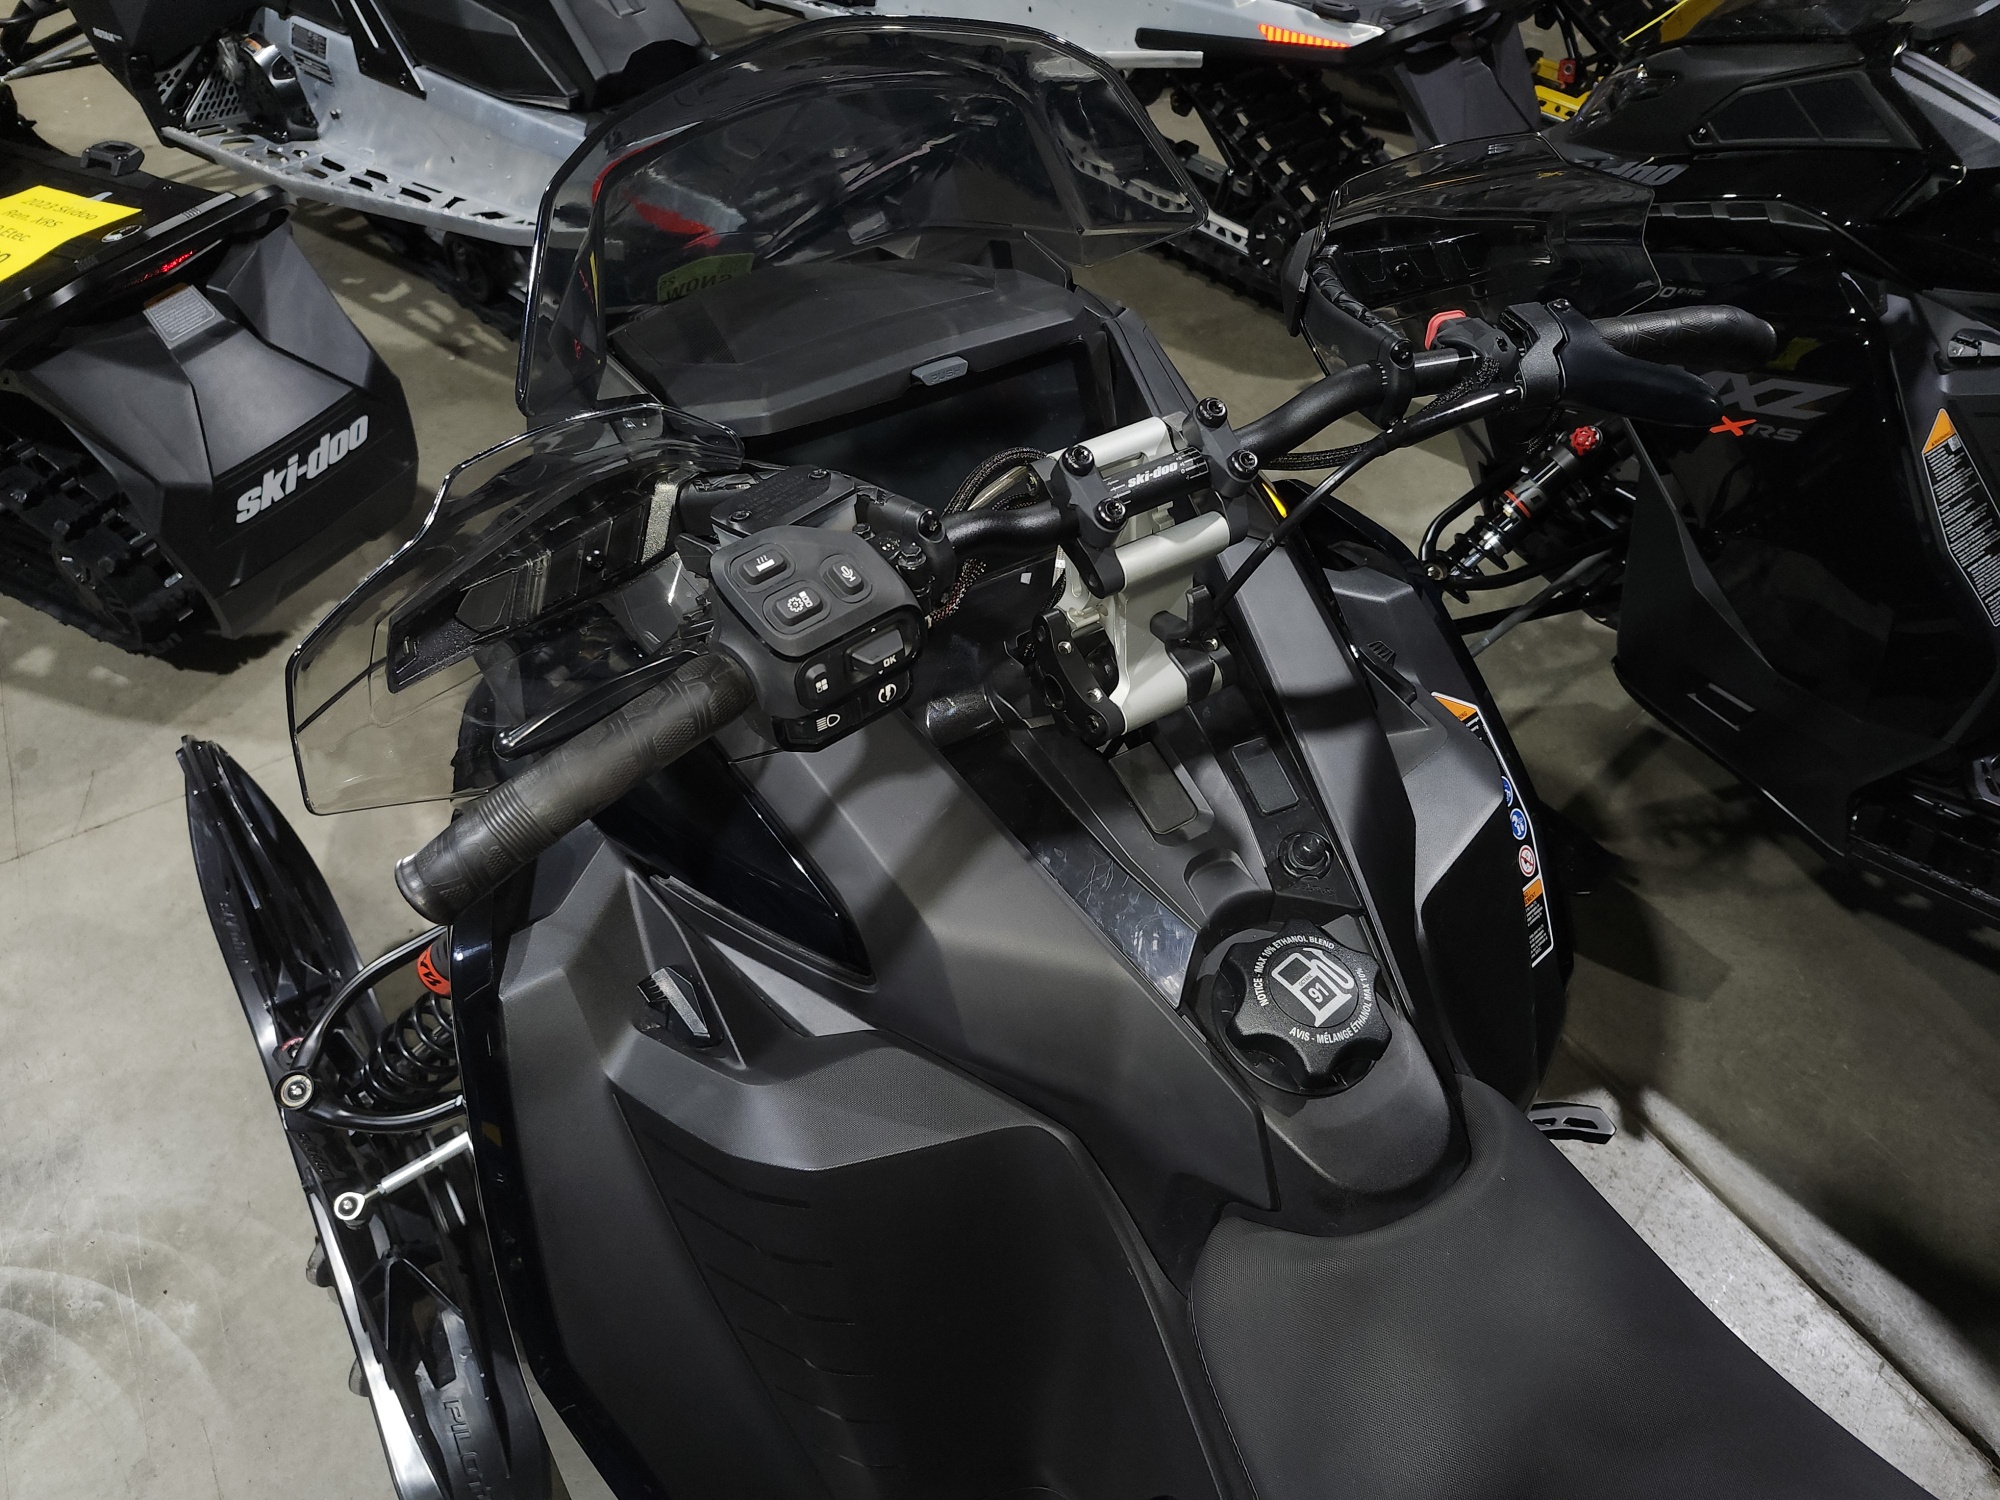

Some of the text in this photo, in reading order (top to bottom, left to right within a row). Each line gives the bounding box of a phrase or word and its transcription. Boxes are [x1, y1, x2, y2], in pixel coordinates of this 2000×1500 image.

[21, 198, 98, 220] 2023 Skidoo
[30, 216, 63, 228] XRS
[930, 365, 960, 383] PUSH
[235, 414, 369, 524] ski-doo
[1127, 461, 1178, 488] ski-doo
[883, 654, 897, 668] OK
[1253, 934, 1335, 1007] NOTICE MAX 10% ETHANOL BLEND
[1308, 982, 1330, 1004] 91
[1288, 967, 1373, 1044] AVIS MÉLANGE ÉTHANOL MAX 10%
